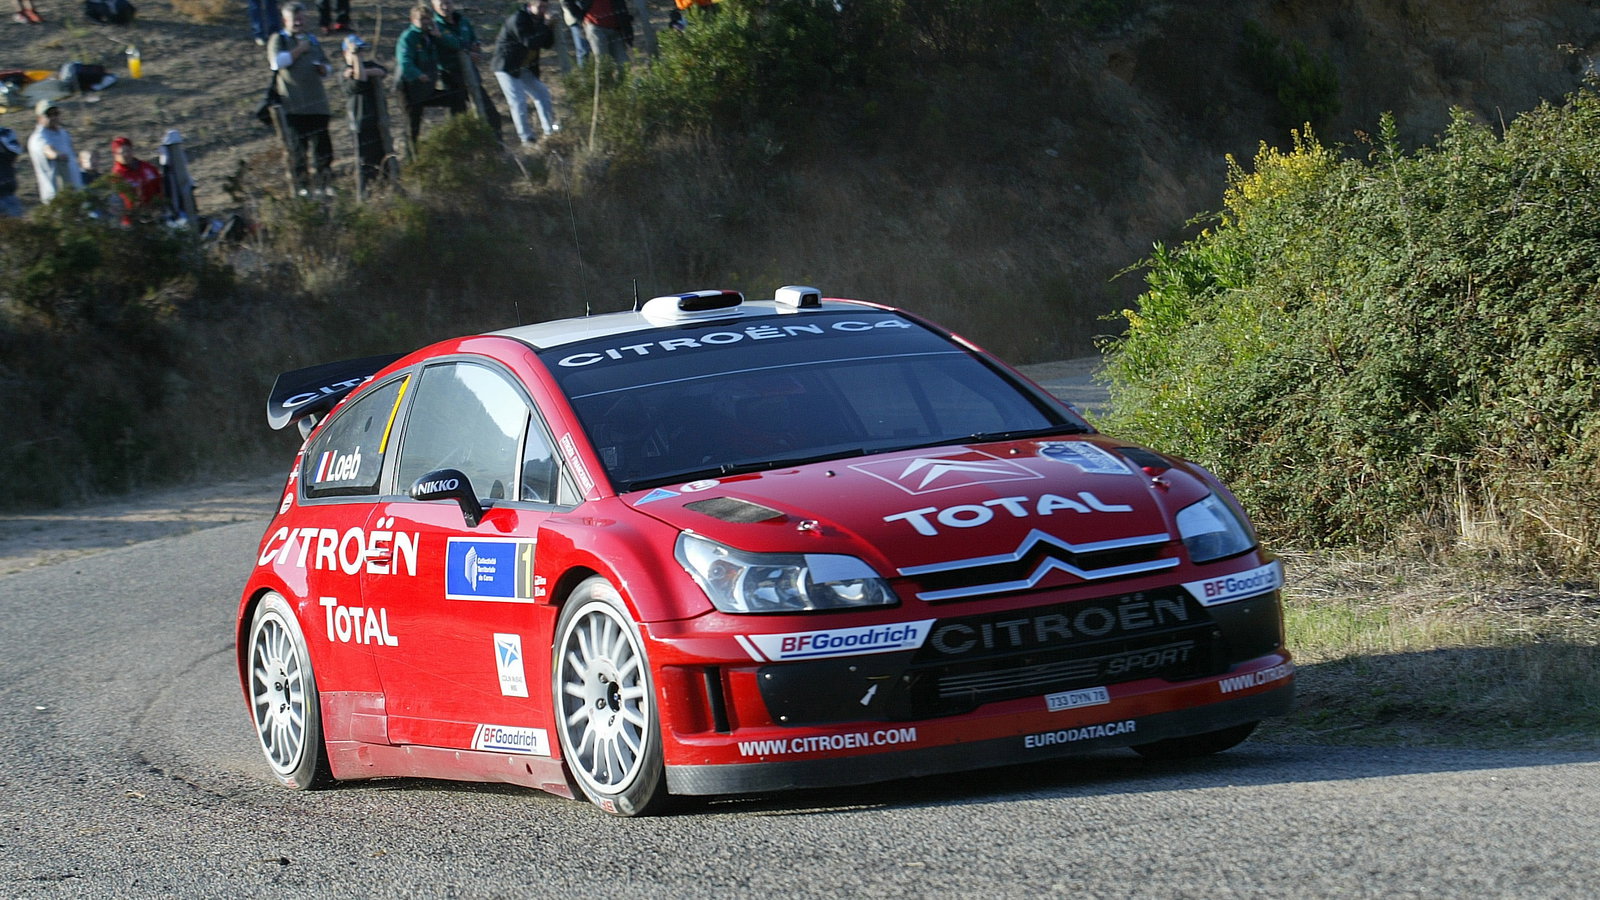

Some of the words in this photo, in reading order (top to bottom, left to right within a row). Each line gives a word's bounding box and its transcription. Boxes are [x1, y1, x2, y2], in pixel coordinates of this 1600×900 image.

[558, 324, 824, 367] CITROËN
[831, 319, 912, 332] C4
[282, 376, 374, 407] CIT
[325, 446, 361, 481] Loeb
[417, 478, 459, 495] NIKKO
[884, 491, 1133, 536] TOTAL
[258, 517, 420, 576] CITROËN
[522, 543, 532, 598] 1
[319, 597, 398, 646] TOTAL
[931, 592, 1190, 655] CITROËN
[781, 625, 917, 653] BFGoodrich
[1107, 644, 1193, 676] SPORT
[1050, 696, 1069, 708] 733
[1070, 692, 1092, 704] DYN
[484, 728, 536, 747] BFGoodrich
[738, 727, 917, 757] WWW.CITROEN.COM
[1024, 720, 1137, 749] EURODATACAR
